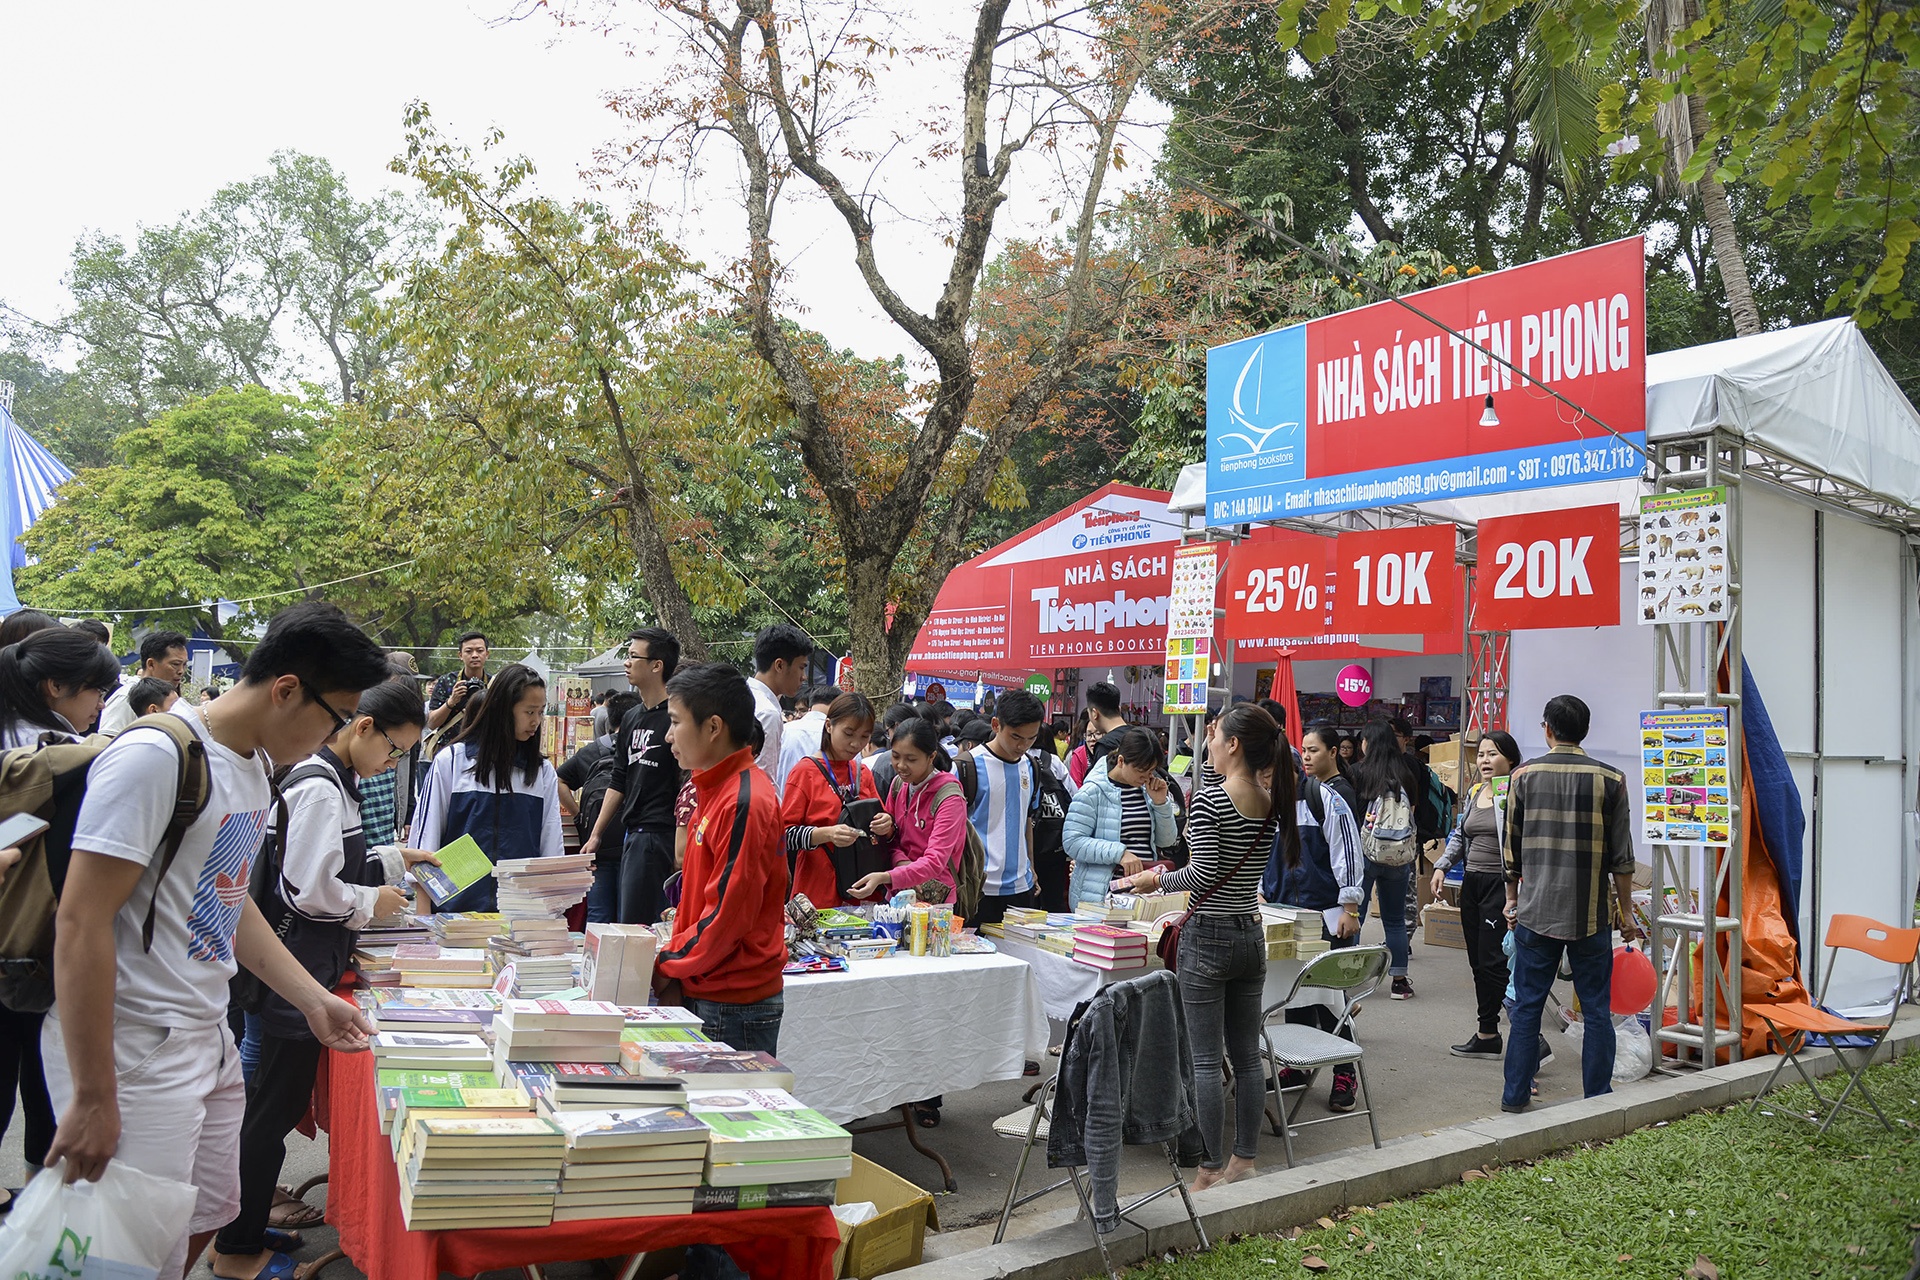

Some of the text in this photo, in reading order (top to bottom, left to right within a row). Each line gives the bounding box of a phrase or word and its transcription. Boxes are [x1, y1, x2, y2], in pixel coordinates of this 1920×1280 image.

[1317, 340, 1366, 425] NHÀ
[1373, 330, 1441, 415] SÁCH
[1521, 293, 1630, 388] PHONG
[1220, 451, 1294, 472] tienphong bookstore
[1231, 498, 1246, 516] 14A
[1247, 496, 1262, 518] ĐẠI
[1263, 494, 1273, 512] LA
[1285, 489, 1312, 510] Email:
[1314, 465, 1508, 506] nhasachtienphong6869.gtv@gmail.com
[1518, 458, 1540, 481] SĐT
[1550, 446, 1635, 478] 0976.347.113
[1113, 530, 1151, 543] PHONG
[1064, 555, 1166, 586] NHÀ SÁCH
[1353, 550, 1434, 606] 10K
[1494, 535, 1594, 600] 20K
[1234, 563, 1318, 613] -25%
[1030, 636, 1168, 655] TIEN PHONG BOOKST
[1026, 684, 1050, 695] -15%
[1339, 678, 1370, 694] -15%
